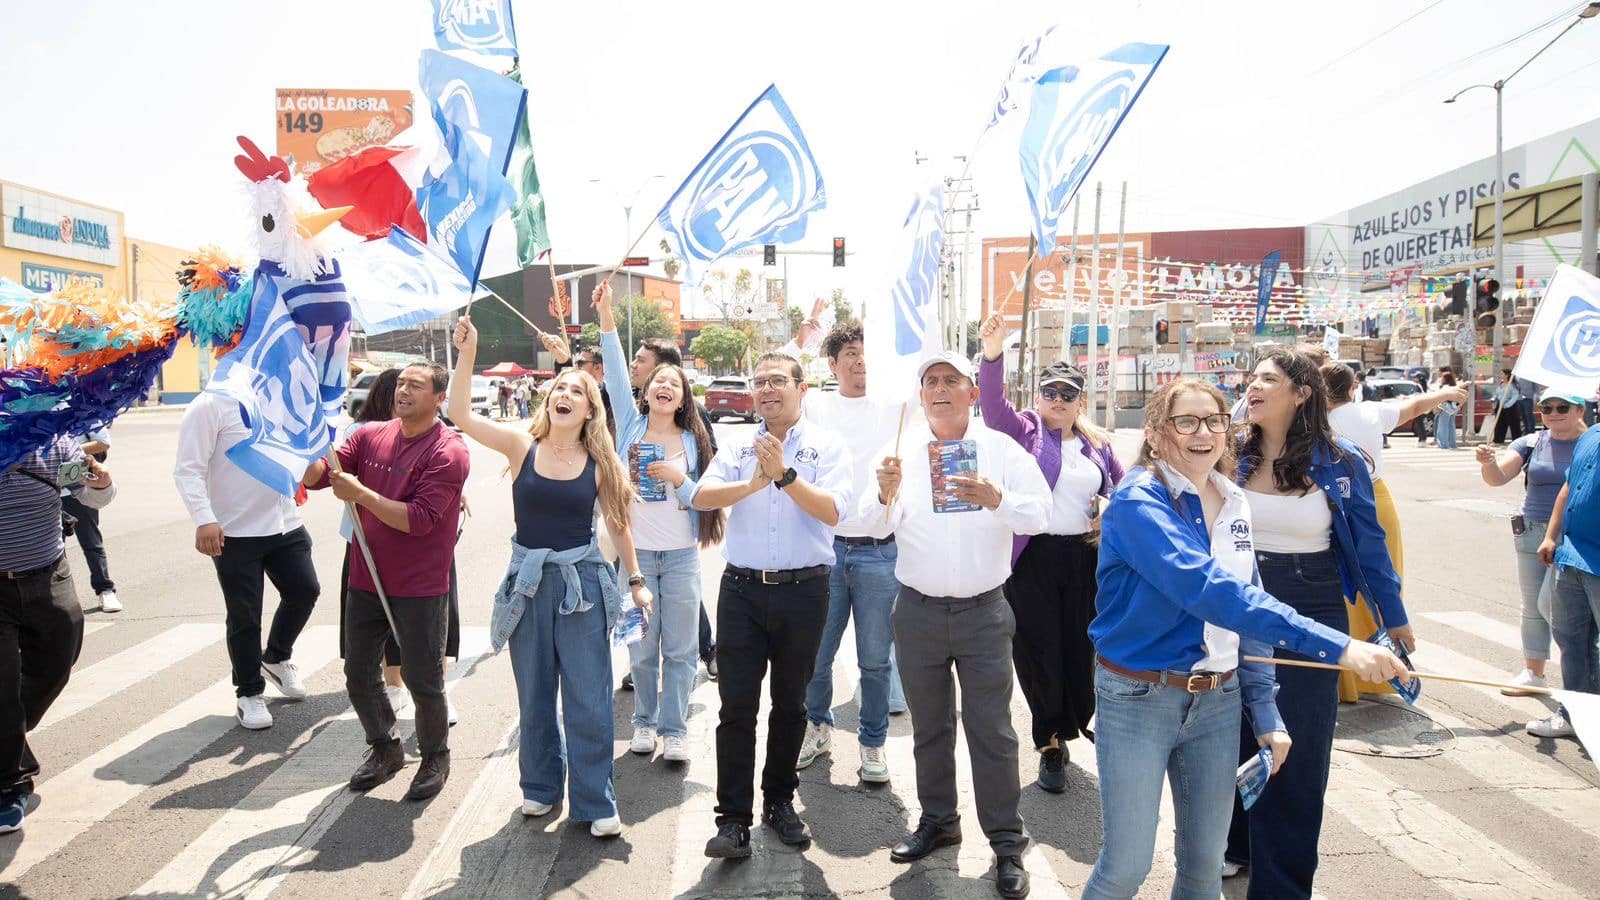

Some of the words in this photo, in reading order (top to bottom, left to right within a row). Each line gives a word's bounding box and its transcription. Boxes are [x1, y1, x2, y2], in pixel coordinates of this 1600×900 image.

[277, 97, 295, 111] LA
[297, 97, 389, 112] GOLEADORA
[1353, 201, 1432, 244] AZULEJOS
[1438, 194, 1449, 218] Y
[1363, 248, 1380, 270] DE
[1383, 222, 1472, 267] QUERETA
[795, 450, 818, 461] PAN
[1230, 524, 1249, 534] PAN
